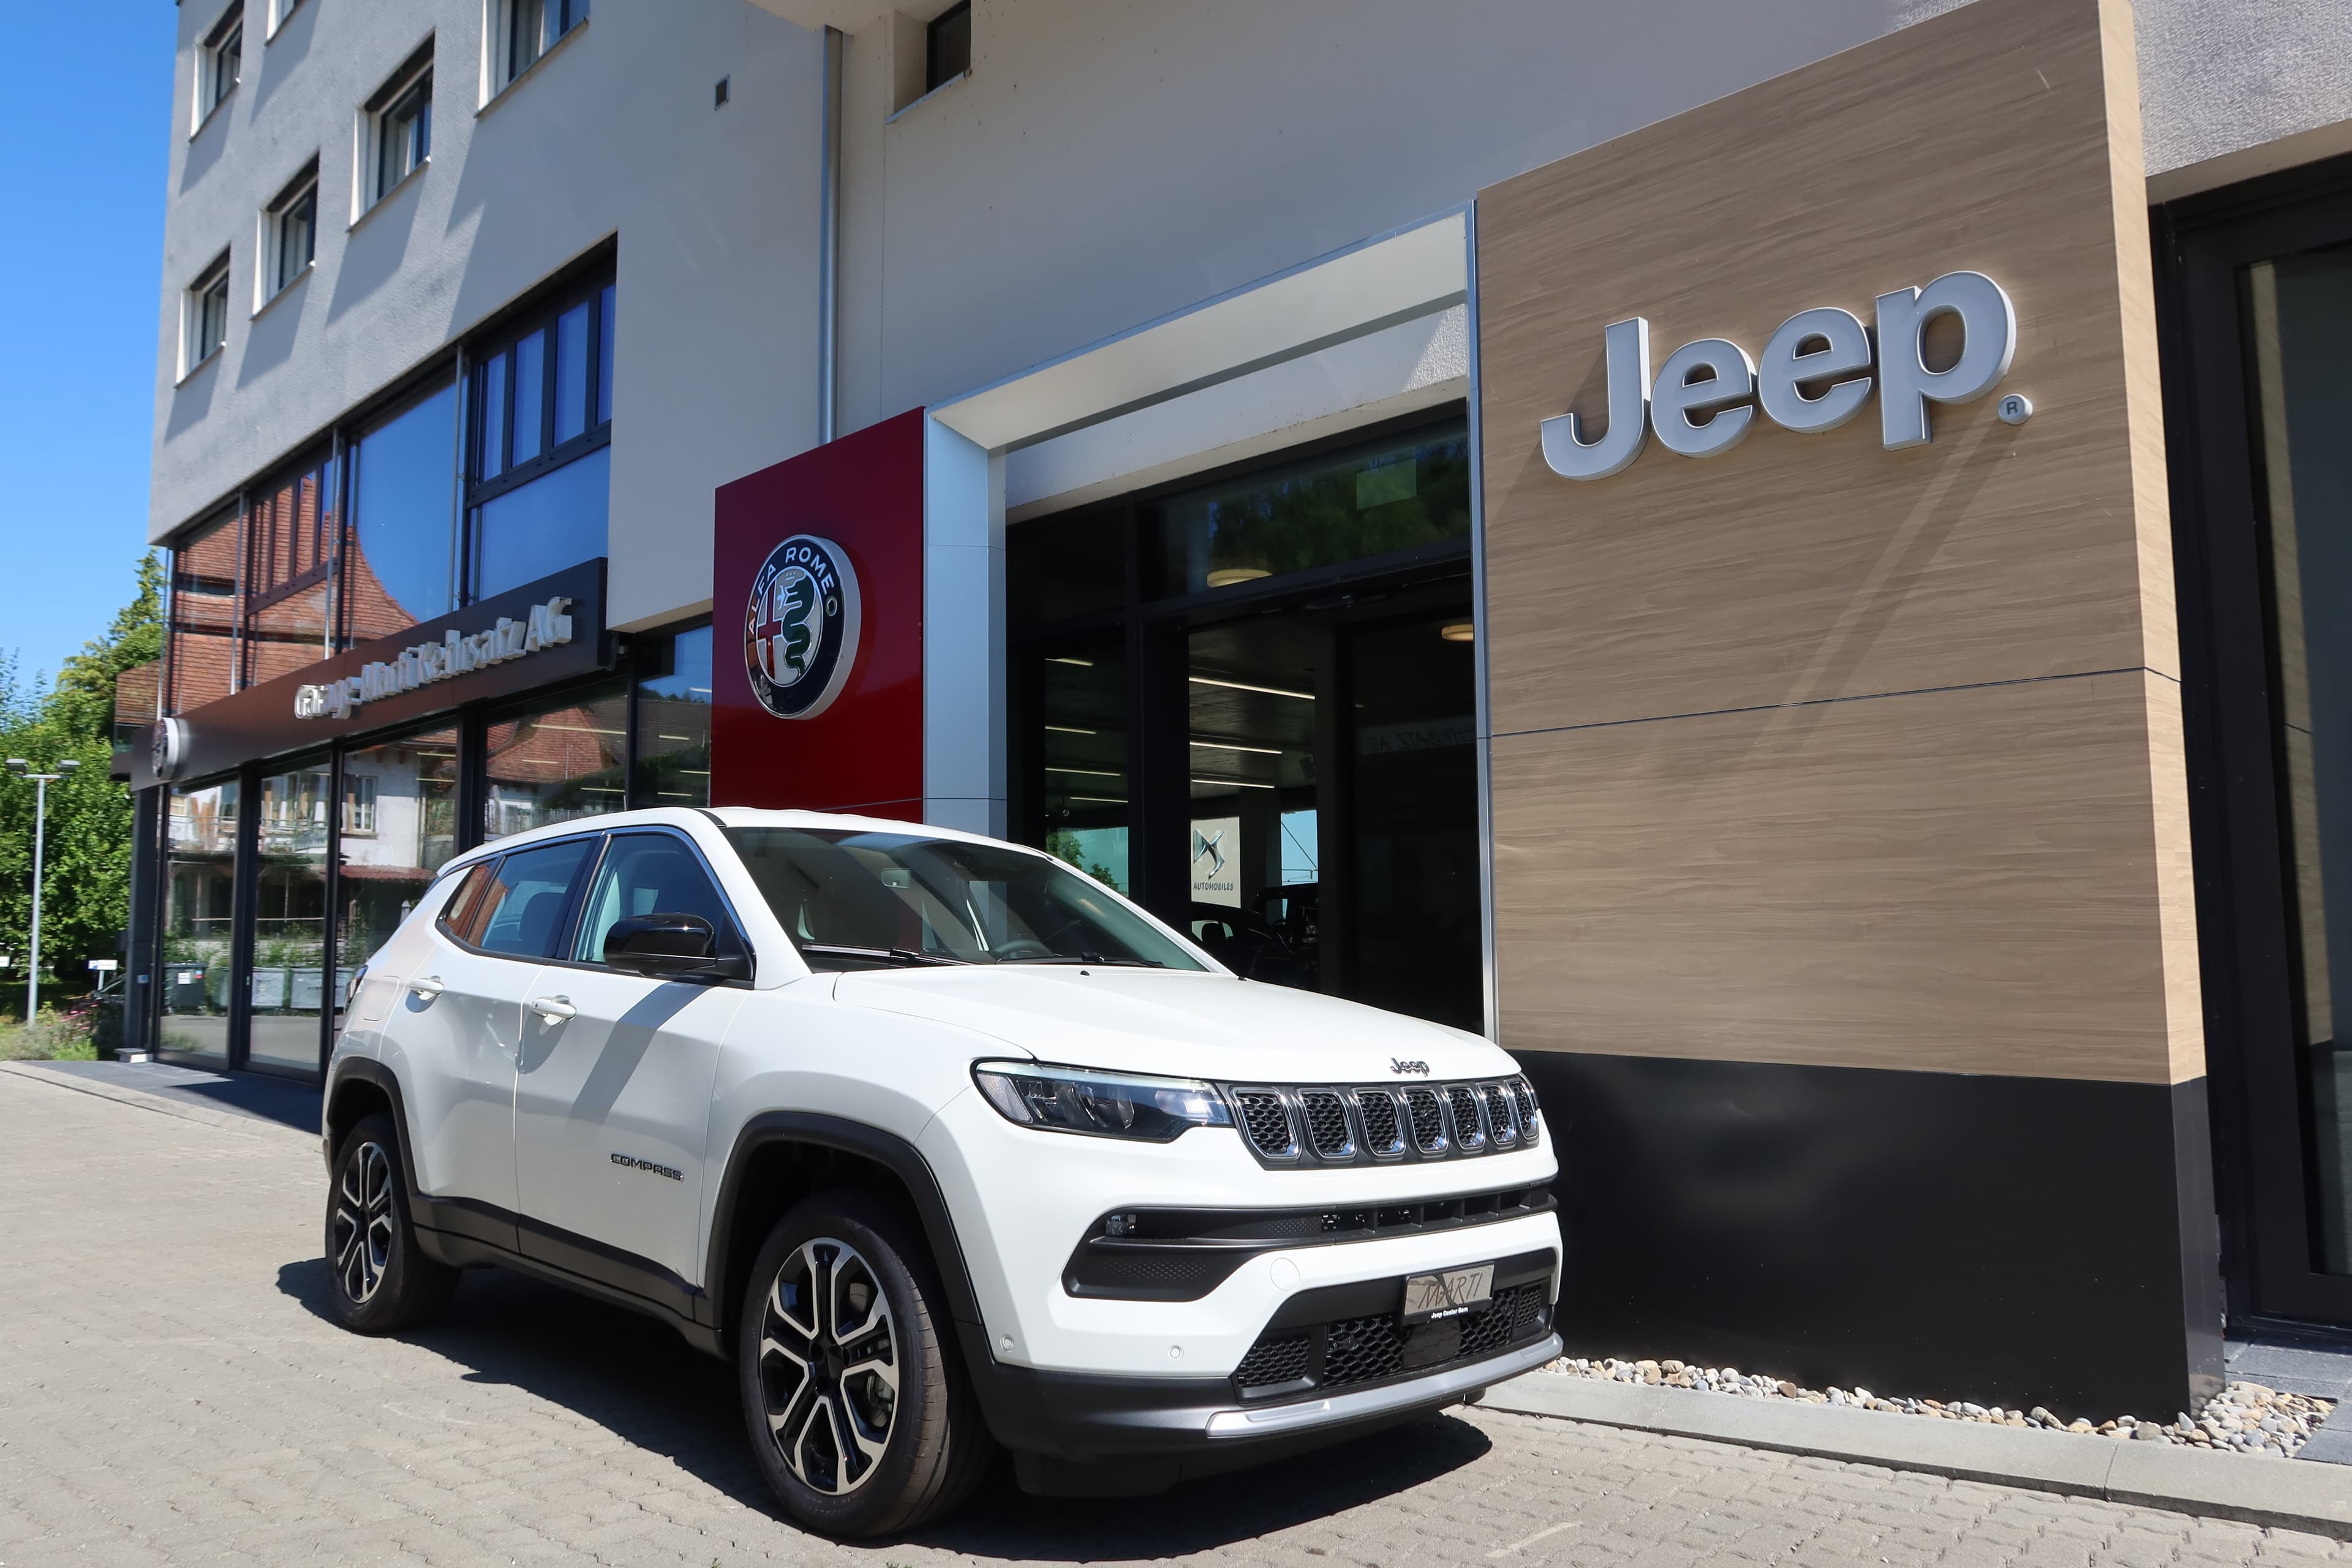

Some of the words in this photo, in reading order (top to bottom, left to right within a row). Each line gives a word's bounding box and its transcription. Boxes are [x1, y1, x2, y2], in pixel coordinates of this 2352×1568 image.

[1540, 270, 2018, 481] Jeep
[748, 563, 777, 635] ALFA
[785, 546, 838, 617] ROMEO
[524, 596, 573, 652] AG
[1193, 881, 1234, 891] AUTOMOBILES
[1390, 1057, 1430, 1077] Jeep
[610, 1153, 684, 1182] COMPASS
